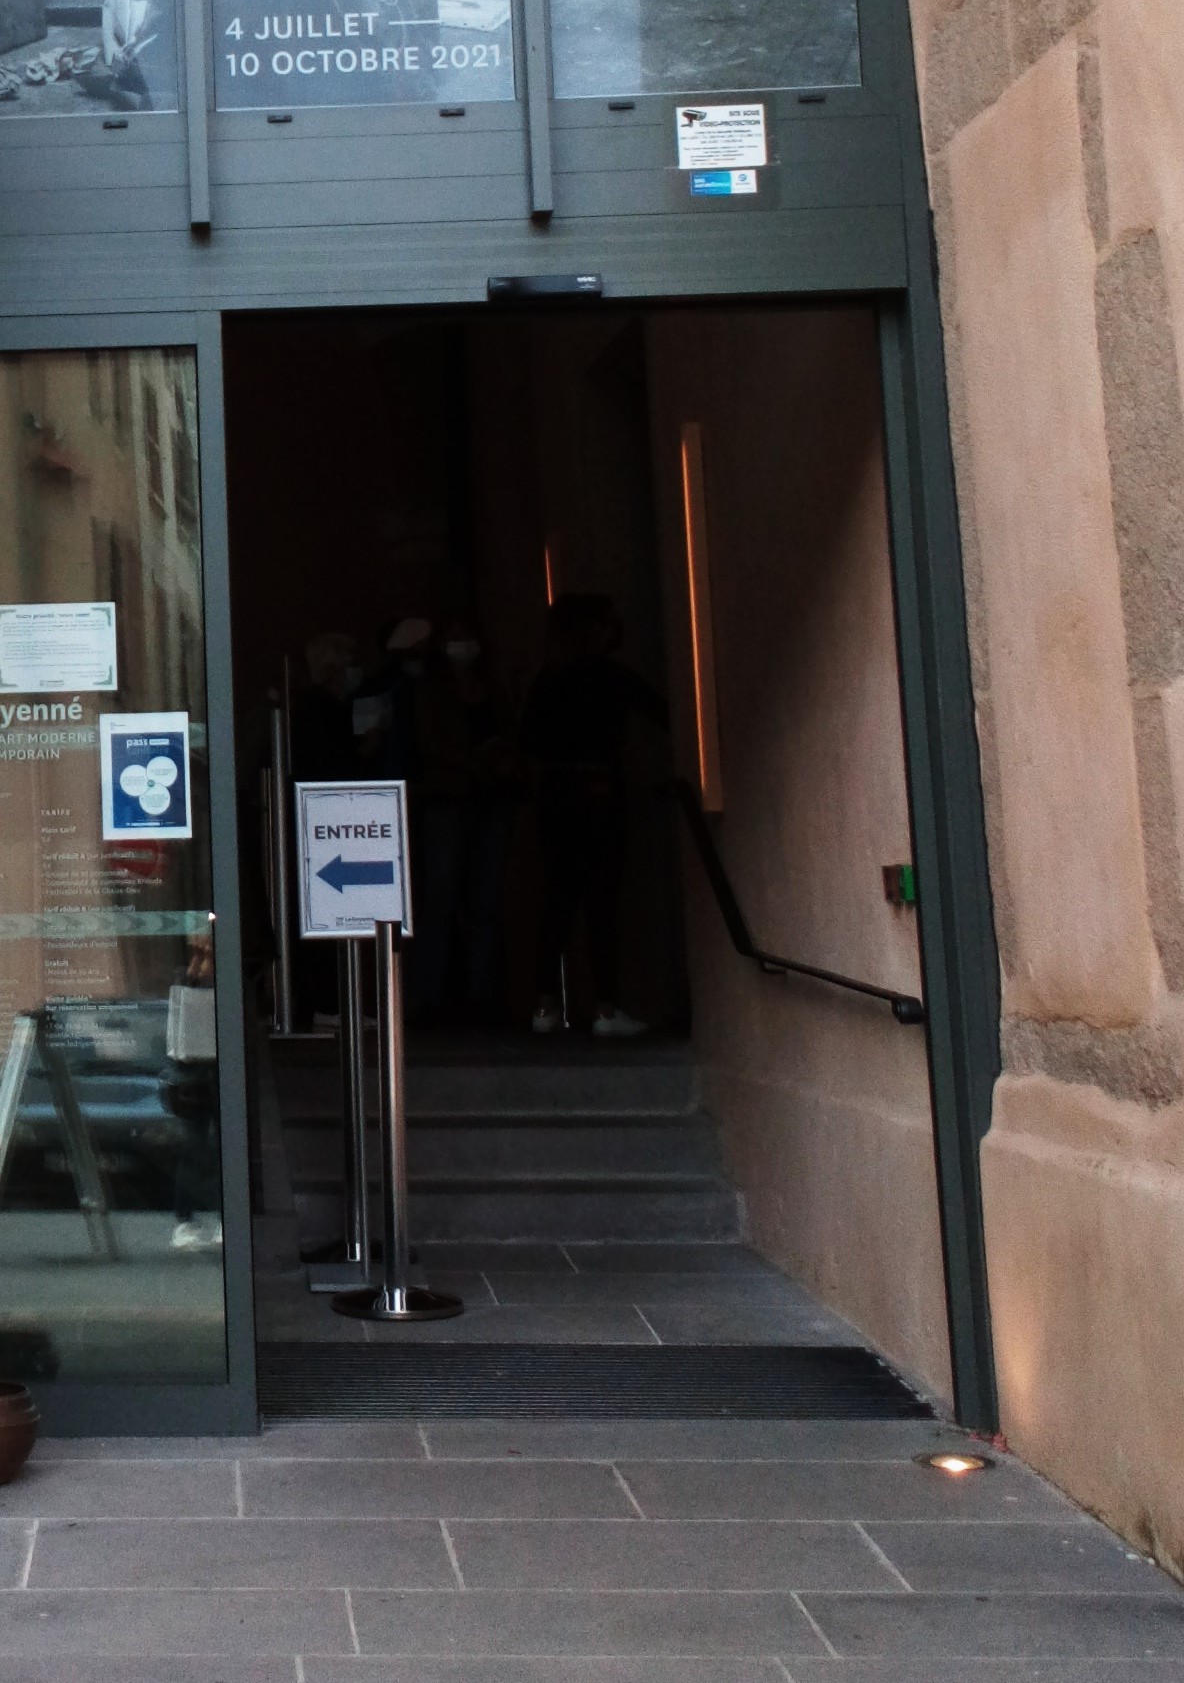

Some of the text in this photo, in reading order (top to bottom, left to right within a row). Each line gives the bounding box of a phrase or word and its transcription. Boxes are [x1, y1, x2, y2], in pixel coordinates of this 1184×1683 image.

[225, 13, 379, 39] 4 JUILLET
[226, 44, 502, 76] 10 OCTOBRE 2021
[27, 731, 96, 744] MODERNE
[314, 820, 392, 840] ENTRÉE
